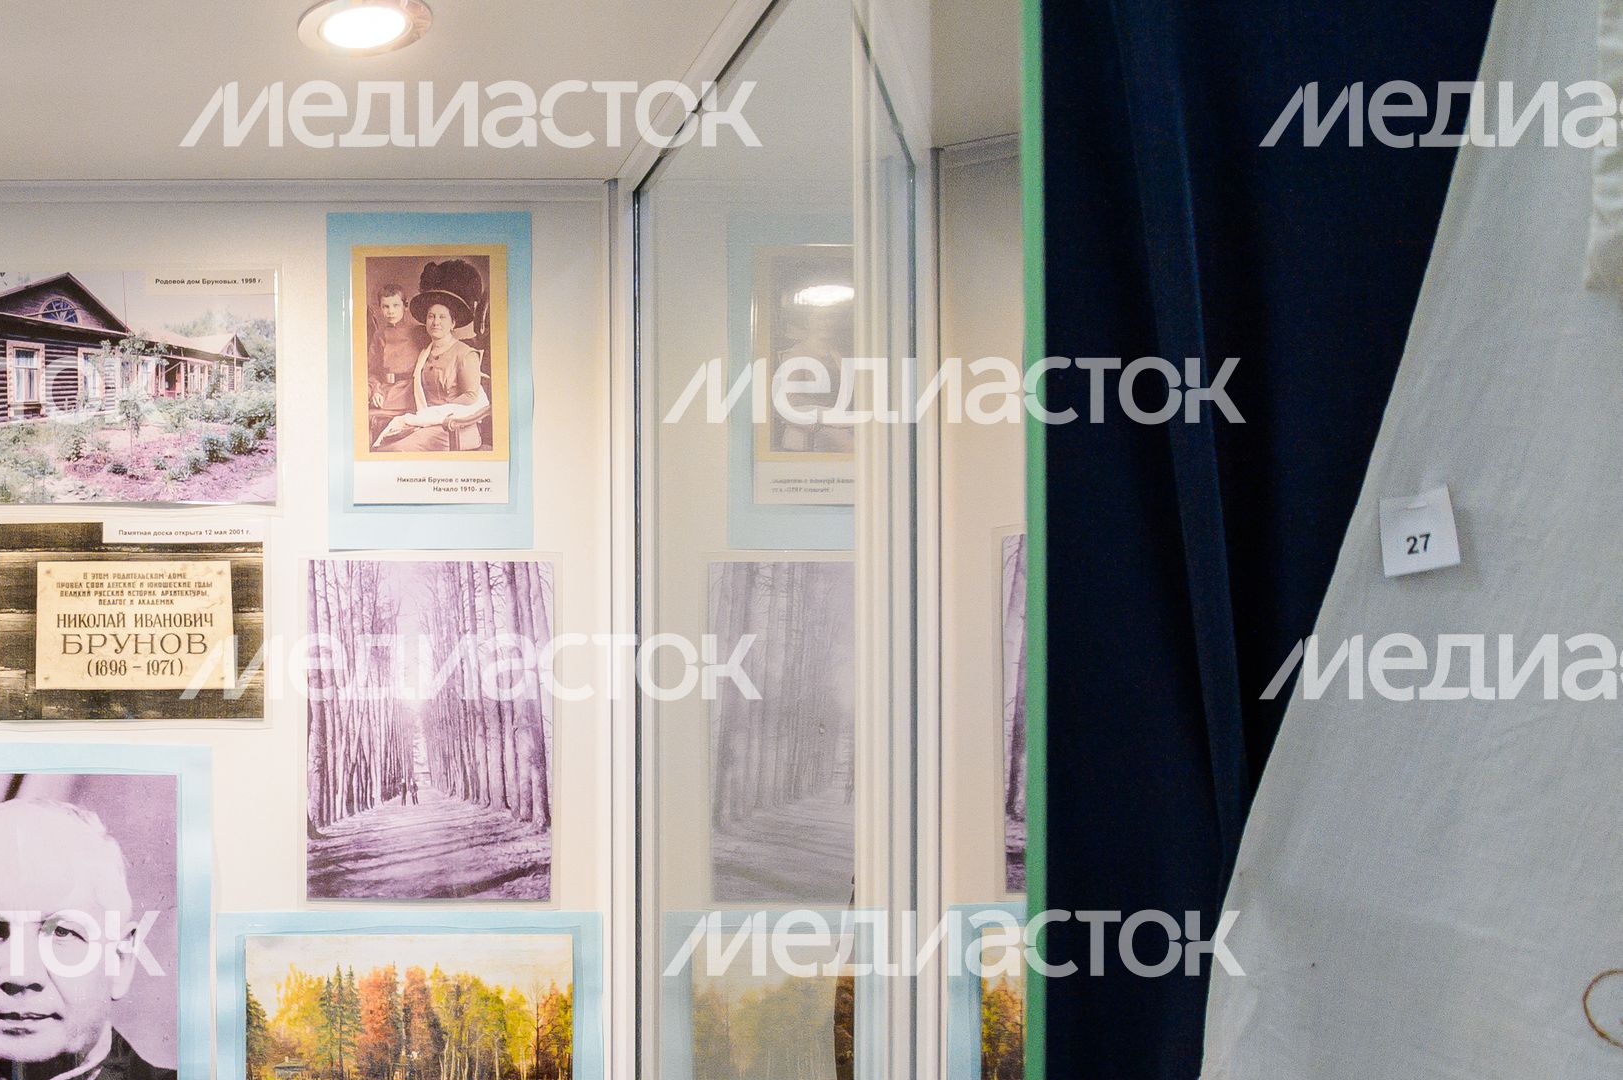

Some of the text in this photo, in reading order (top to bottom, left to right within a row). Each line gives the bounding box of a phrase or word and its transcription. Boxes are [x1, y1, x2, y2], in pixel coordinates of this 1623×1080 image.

[1406, 533, 1431, 555] 27
[56, 612, 213, 628] НИКОЛАЙ ИВАНОВИЧ
[62, 633, 208, 654] БРУНОВ
[87, 659, 127, 677] (1898
[146, 658, 183, 676] 1971)
